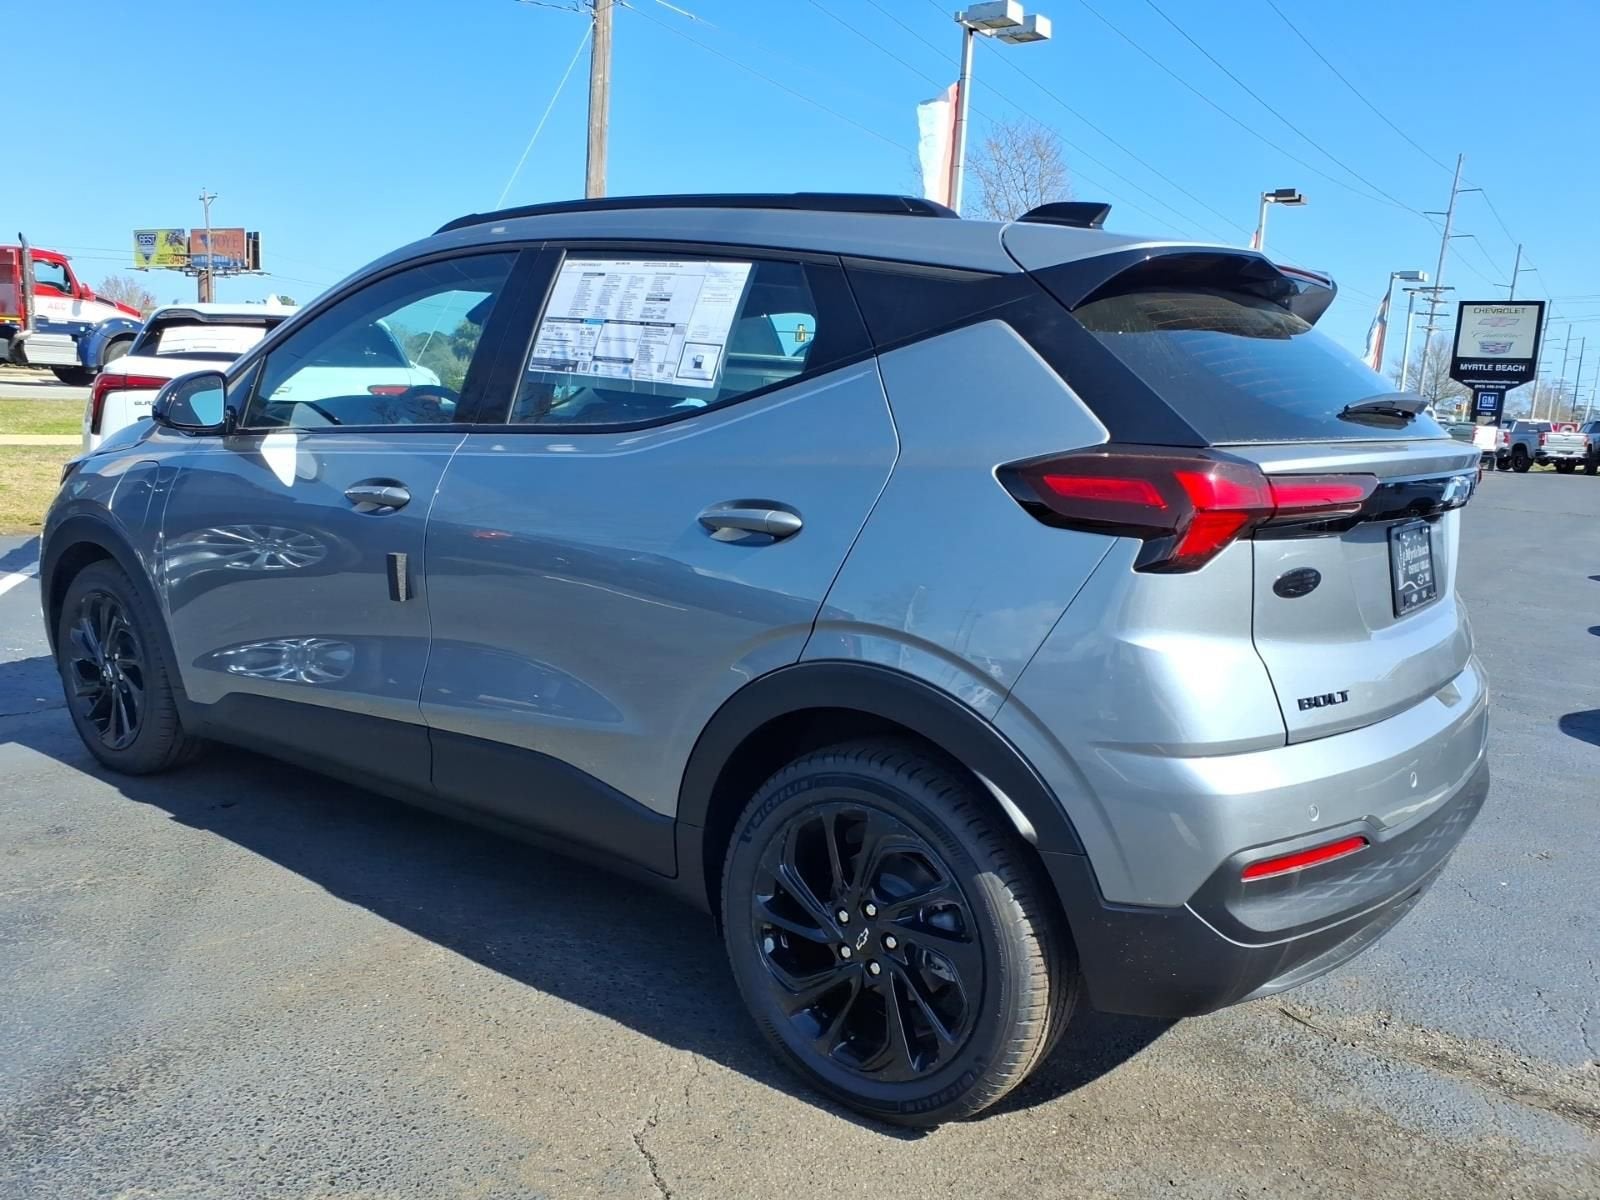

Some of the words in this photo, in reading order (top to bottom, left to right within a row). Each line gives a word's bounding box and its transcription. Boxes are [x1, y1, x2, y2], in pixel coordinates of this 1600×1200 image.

[1460, 363, 1494, 371] MYRTLE
[1495, 364, 1526, 372] BEACH
[1481, 396, 1495, 404] GM
[1296, 689, 1350, 711] BOLT
